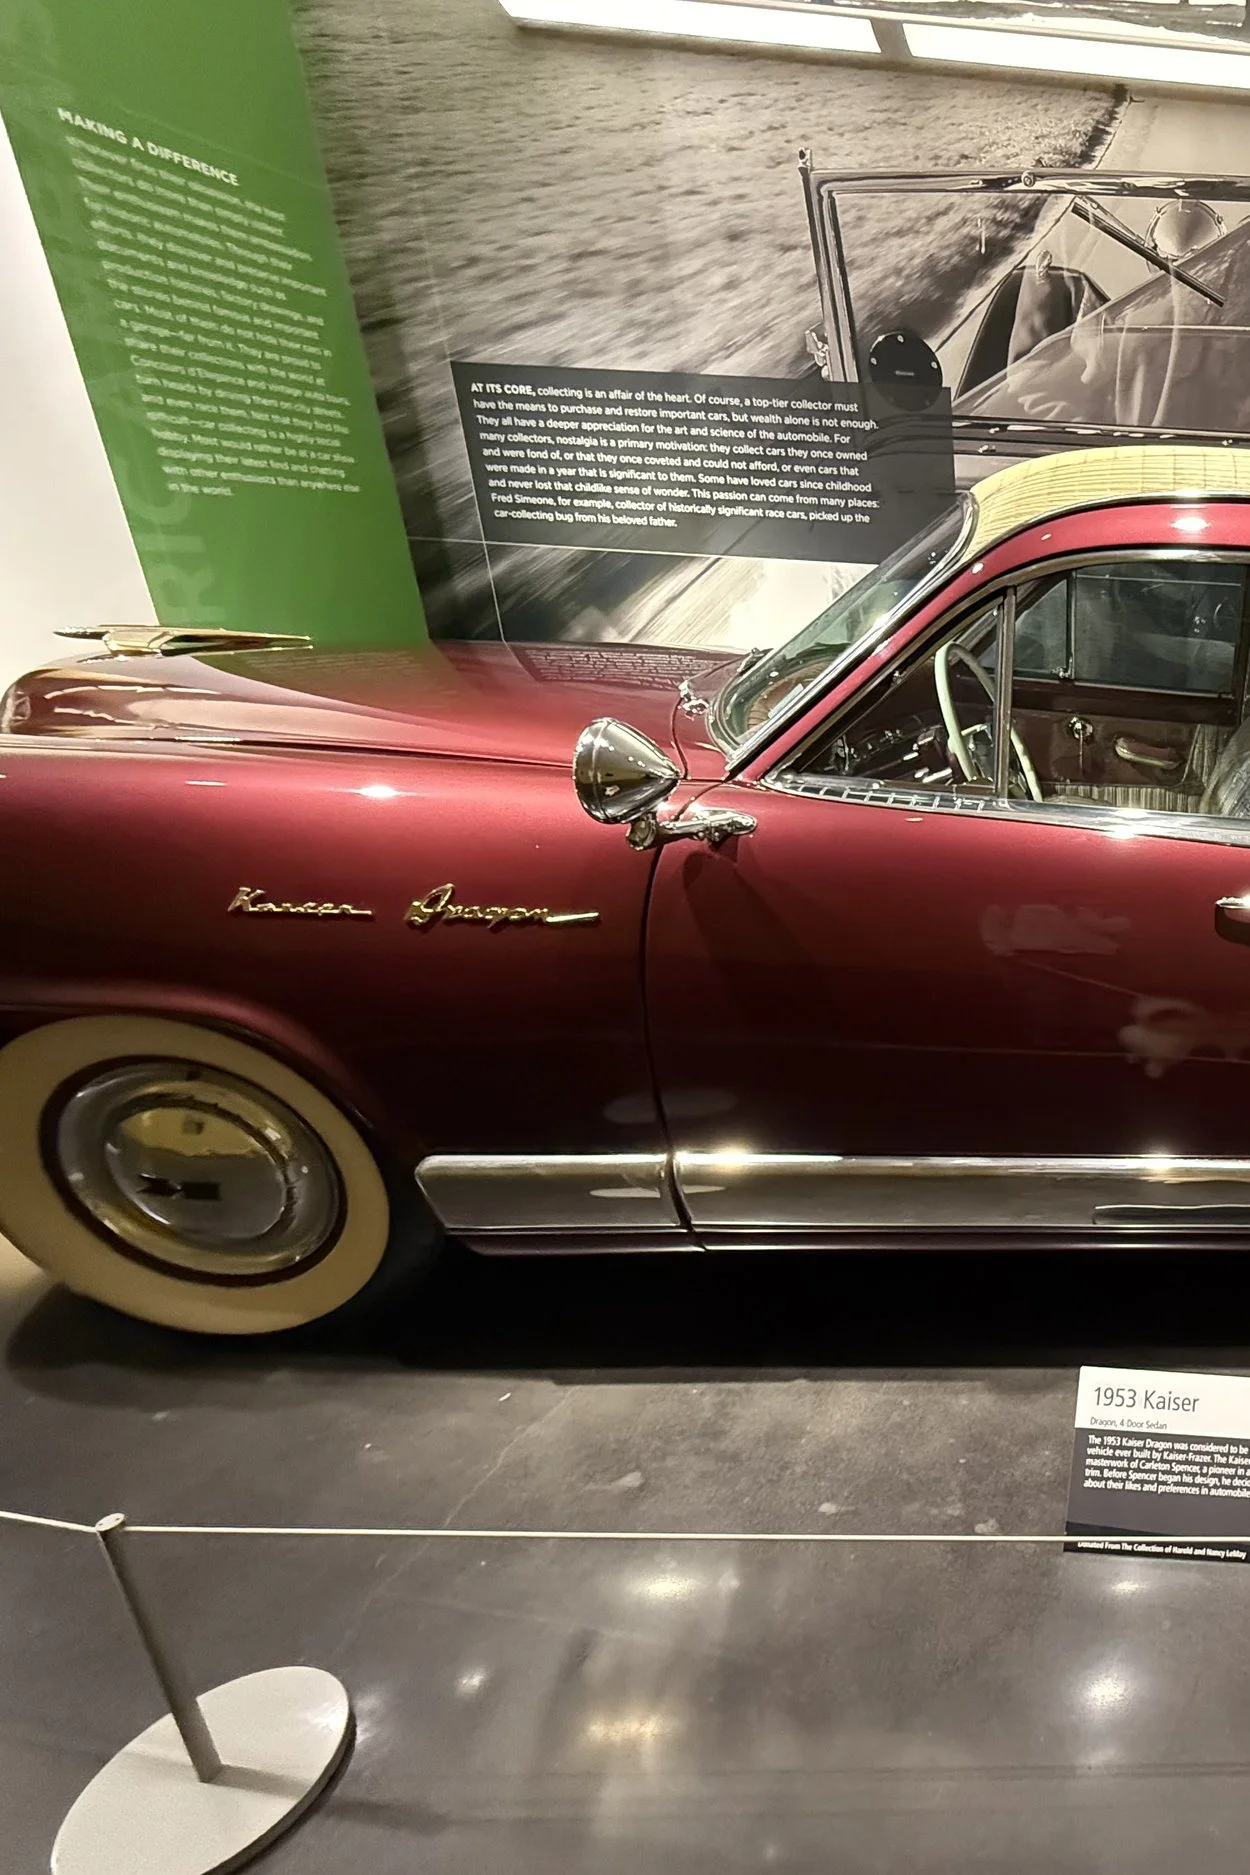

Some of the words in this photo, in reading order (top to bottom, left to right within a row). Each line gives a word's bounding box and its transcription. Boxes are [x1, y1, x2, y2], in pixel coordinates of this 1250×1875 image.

[57, 107, 128, 145] MAKING
[131, 136, 145, 151] A
[147, 141, 240, 187] DIFFERENCE
[471, 382, 483, 392] AT
[485, 383, 502, 393] ITS
[503, 384, 535, 396] CORE,
[537, 386, 582, 399] collecting
[584, 388, 592, 398] is
[594, 390, 606, 398] an
[608, 389, 632, 399] affair
[634, 390, 644, 400] of
[646, 391, 662, 401] the
[693, 393, 705, 403] Of
[708, 396, 742, 407] course,
[744, 398, 750, 406] a
[752, 397, 788, 408] top-tier
[790, 399, 832, 410] collector
[834, 402, 858, 412] must
[472, 398, 495, 409] have
[497, 400, 513, 410] the
[515, 402, 546, 411] means
[547, 403, 558, 412] to
[560, 404, 602, 414] purchase
[604, 405, 622, 415] and
[624, 407, 657, 417] restore
[659, 408, 706, 420] important
[707, 412, 730, 422] cars,
[731, 411, 748, 422] but
[750, 413, 782, 423] wealth
[783, 414, 809, 425] alone
[811, 416, 819, 426] is
[821, 418, 838, 427] not
[840, 419, 878, 430] enough.
[228, 886, 373, 916] Kaiser
[404, 883, 600, 929] Dragon
[1094, 1386, 1136, 1407] 1953
[1143, 1389, 1199, 1412] Kaiser
[1089, 1416, 1117, 1428] Dragon,
[1145, 1420, 1167, 1430] Sedan
[1088, 1434, 1101, 1444] The
[1103, 1435, 1120, 1445] 1953
[1121, 1437, 1144, 1447] Kaiser
[1145, 1438, 1172, 1450] Dragon
[1173, 1442, 1188, 1450] was
[1189, 1442, 1228, 1453] considered
[1229, 1444, 1237, 1453] to
[1238, 1444, 1248, 1454] be
[1086, 1446, 1113, 1456] vehicle
[1132, 1448, 1150, 1458] built
[1151, 1450, 1161, 1462] by
[1213, 1453, 1227, 1463] The
[1228, 1455, 1250, 1465] Kaiser
[1084, 1467, 1101, 1477] trim.
[1103, 1468, 1127, 1478] Before
[1128, 1470, 1157, 1484] Spencer
[1157, 1472, 1181, 1485] began
[1182, 1474, 1193, 1483] his
[1194, 1475, 1220, 1488] design,
[1221, 1476, 1231, 1485] he
[1085, 1458, 1128, 1469] masterwork
[1129, 1460, 1138, 1470] of
[1139, 1460, 1170, 1472] Carleton
[1208, 1466, 1235, 1478] pioneer
[1237, 1467, 1244, 1475] in
[1083, 1478, 1105, 1488] about
[1106, 1479, 1123, 1489] their
[1124, 1480, 1141, 1490] likes
[1142, 1482, 1157, 1491] and
[1157, 1483, 1199, 1494] preferences
[1200, 1485, 1208, 1494] in
[1121, 1542, 1132, 1550] The
[1133, 1543, 1163, 1552] Collection
[1164, 1545, 1172, 1553] of
[1193, 1547, 1205, 1555] and
